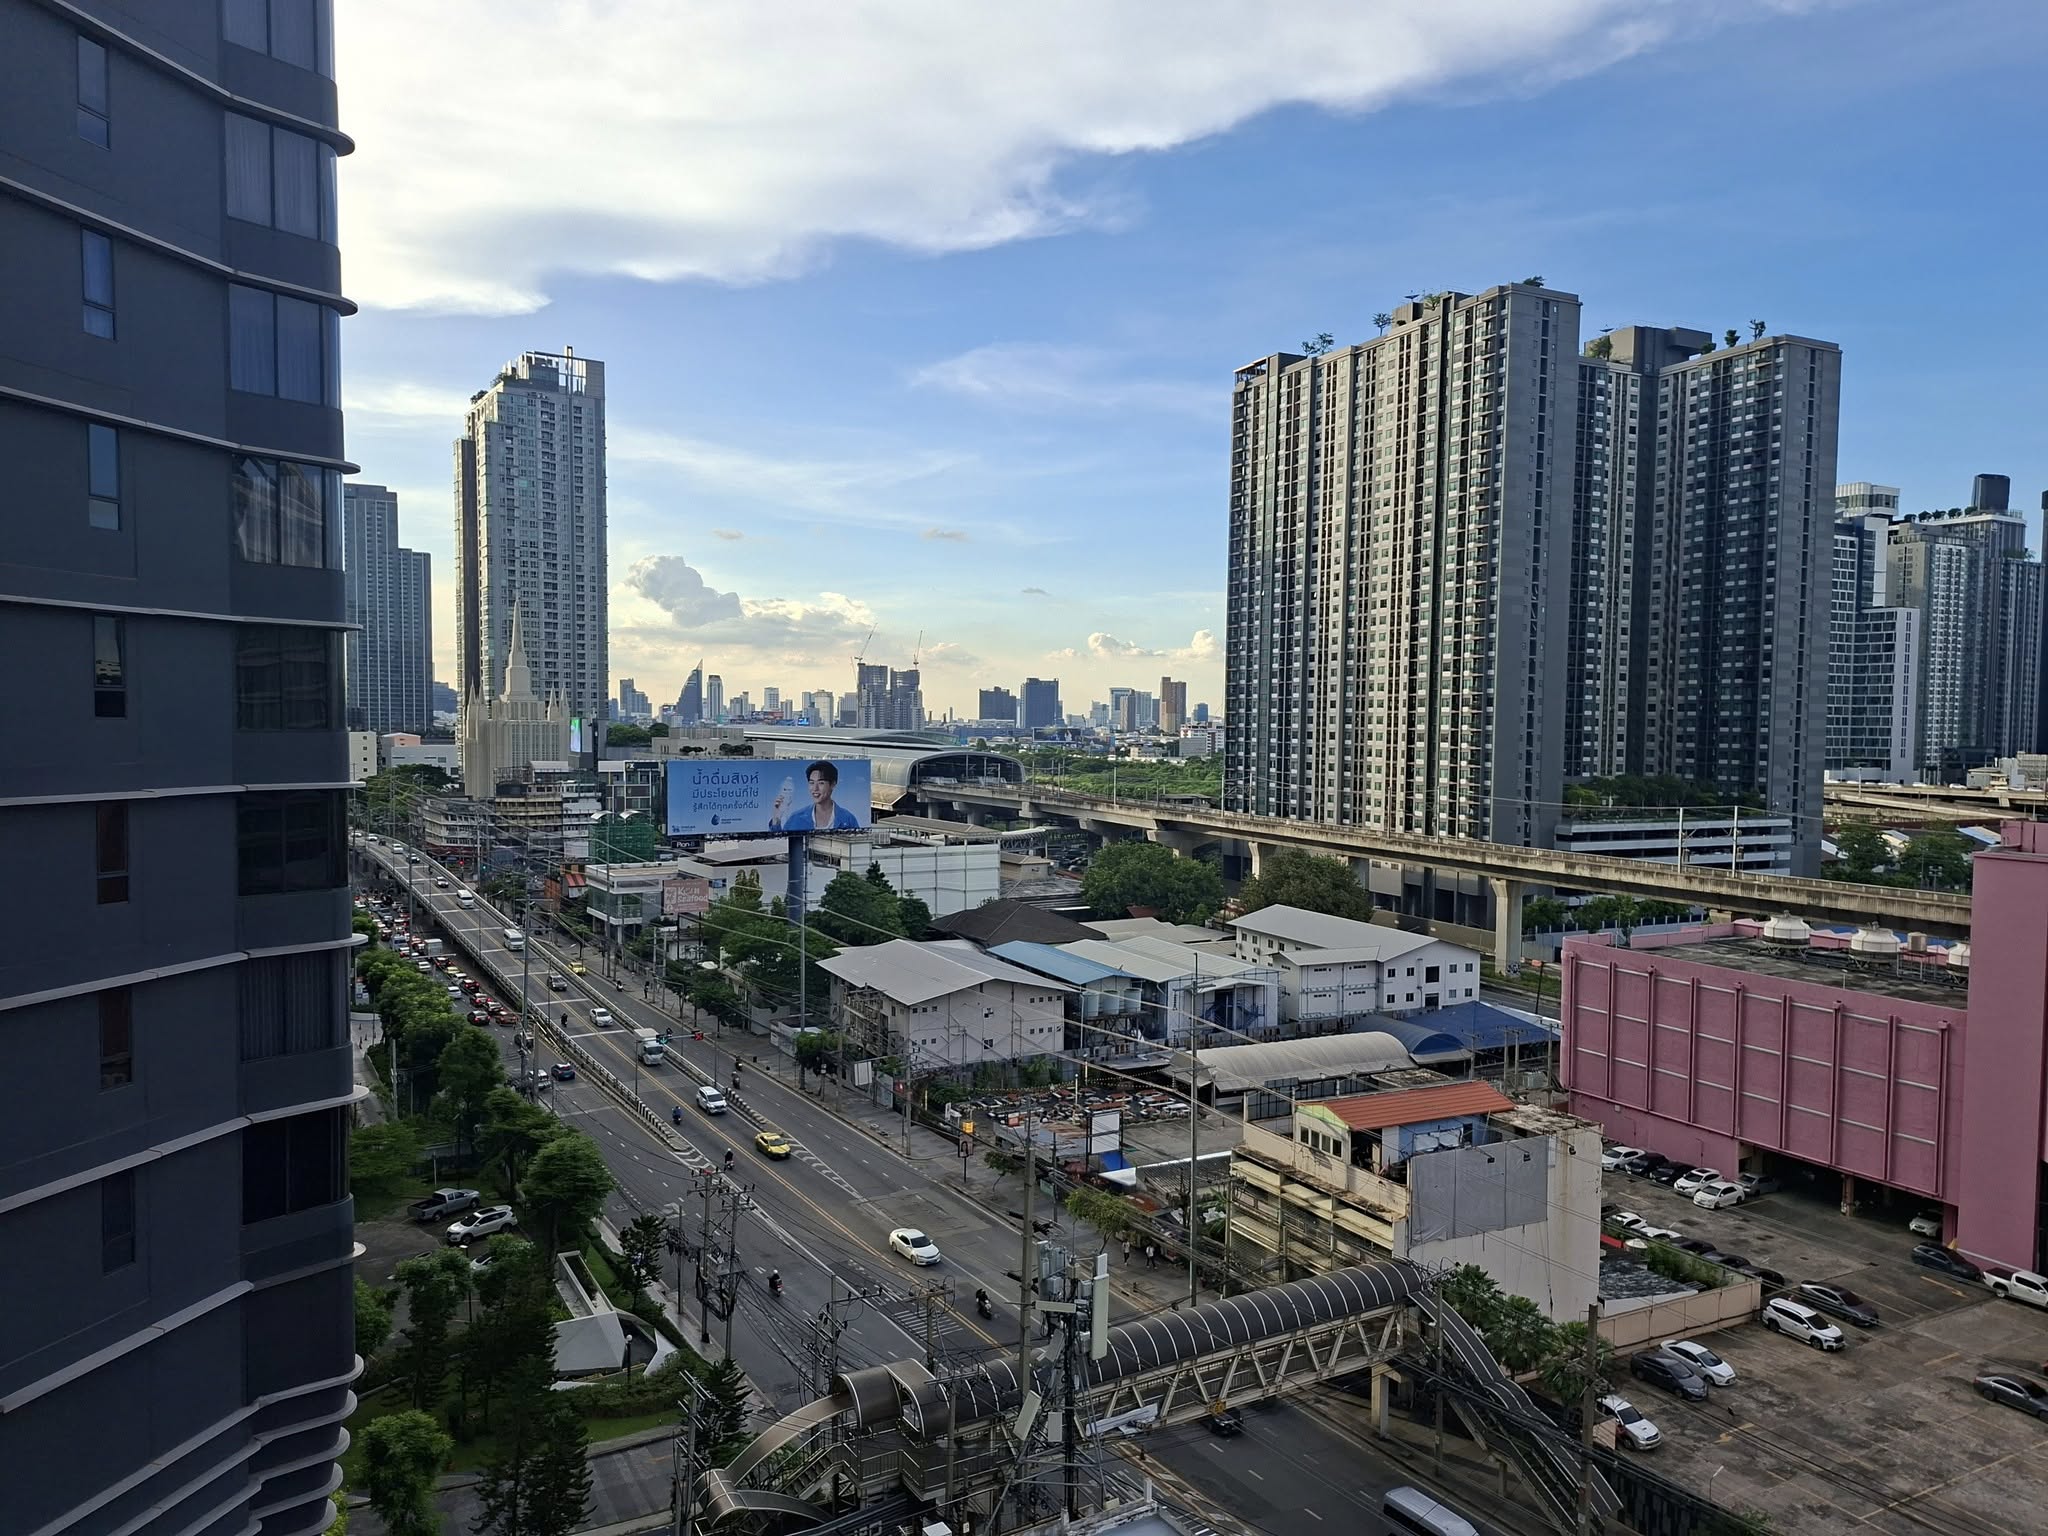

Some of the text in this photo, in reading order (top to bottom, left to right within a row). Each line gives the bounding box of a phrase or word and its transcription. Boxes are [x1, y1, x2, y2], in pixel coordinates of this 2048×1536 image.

[692, 768, 759, 785] น้ำดื่มสิงห์
[692, 785, 759, 799] มีประโยชน์ที่ใช่
